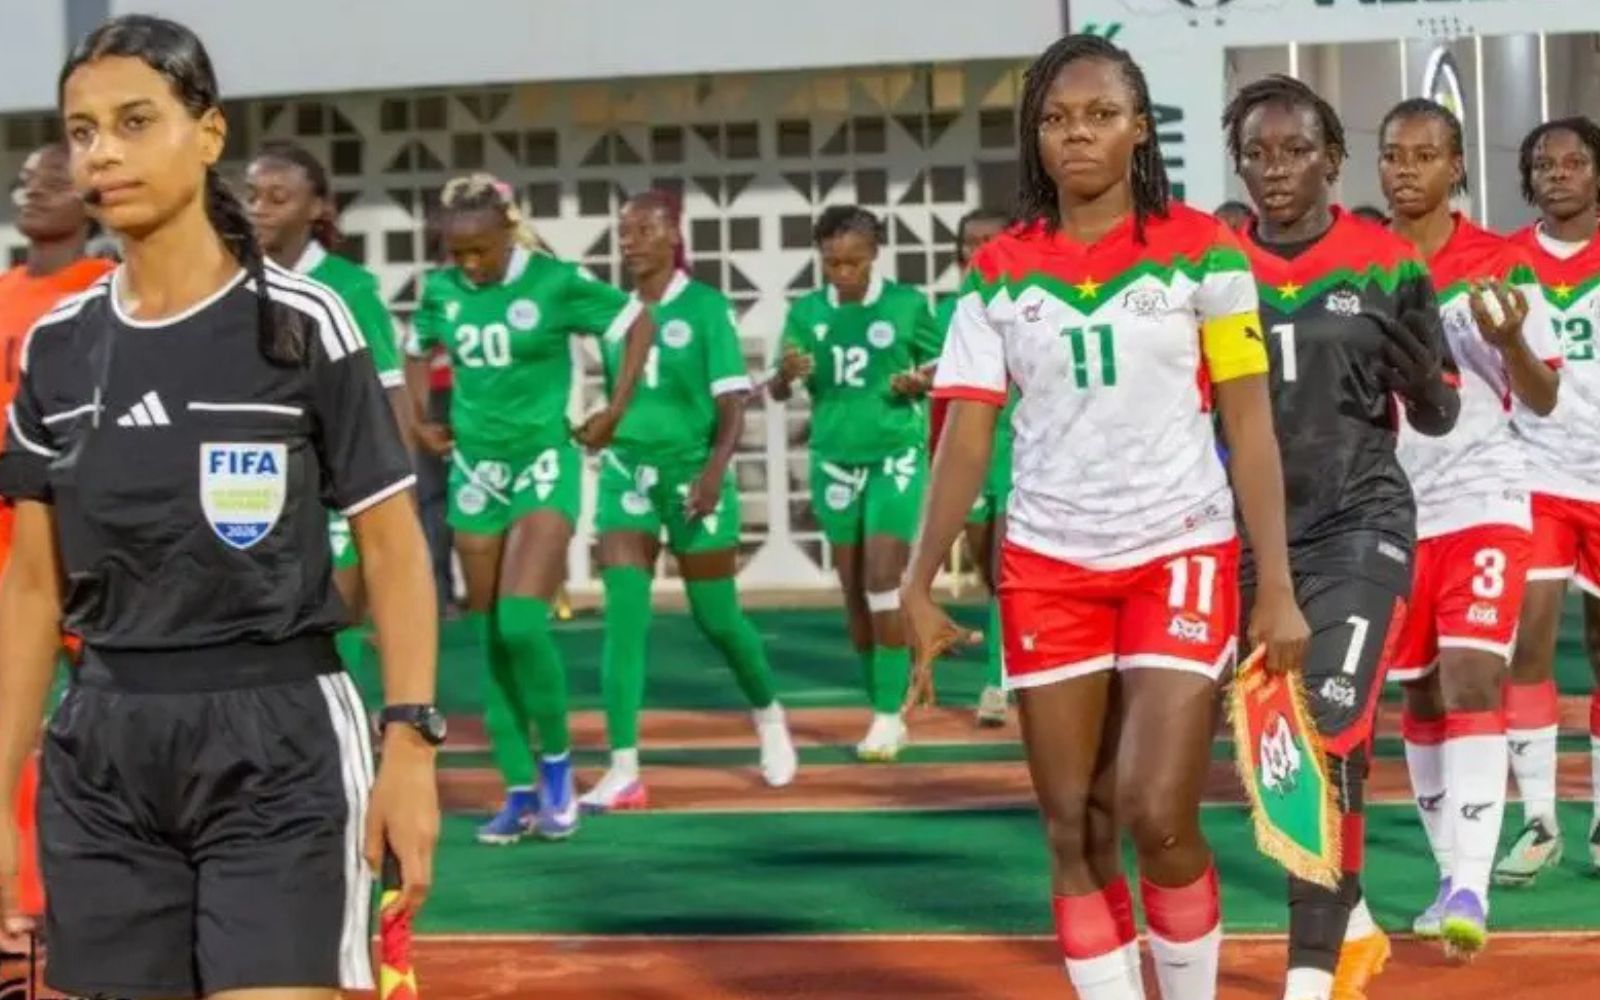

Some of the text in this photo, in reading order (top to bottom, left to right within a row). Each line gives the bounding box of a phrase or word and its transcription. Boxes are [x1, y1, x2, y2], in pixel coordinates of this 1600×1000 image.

[455, 323, 510, 367] 20
[832, 345, 868, 387] 12
[1060, 324, 1117, 389] 11
[1271, 323, 1297, 383] 1
[209, 451, 279, 475] FIFA
[1164, 555, 1217, 614] 11
[1472, 548, 1507, 599] 3
[1346, 615, 1370, 675] 1
